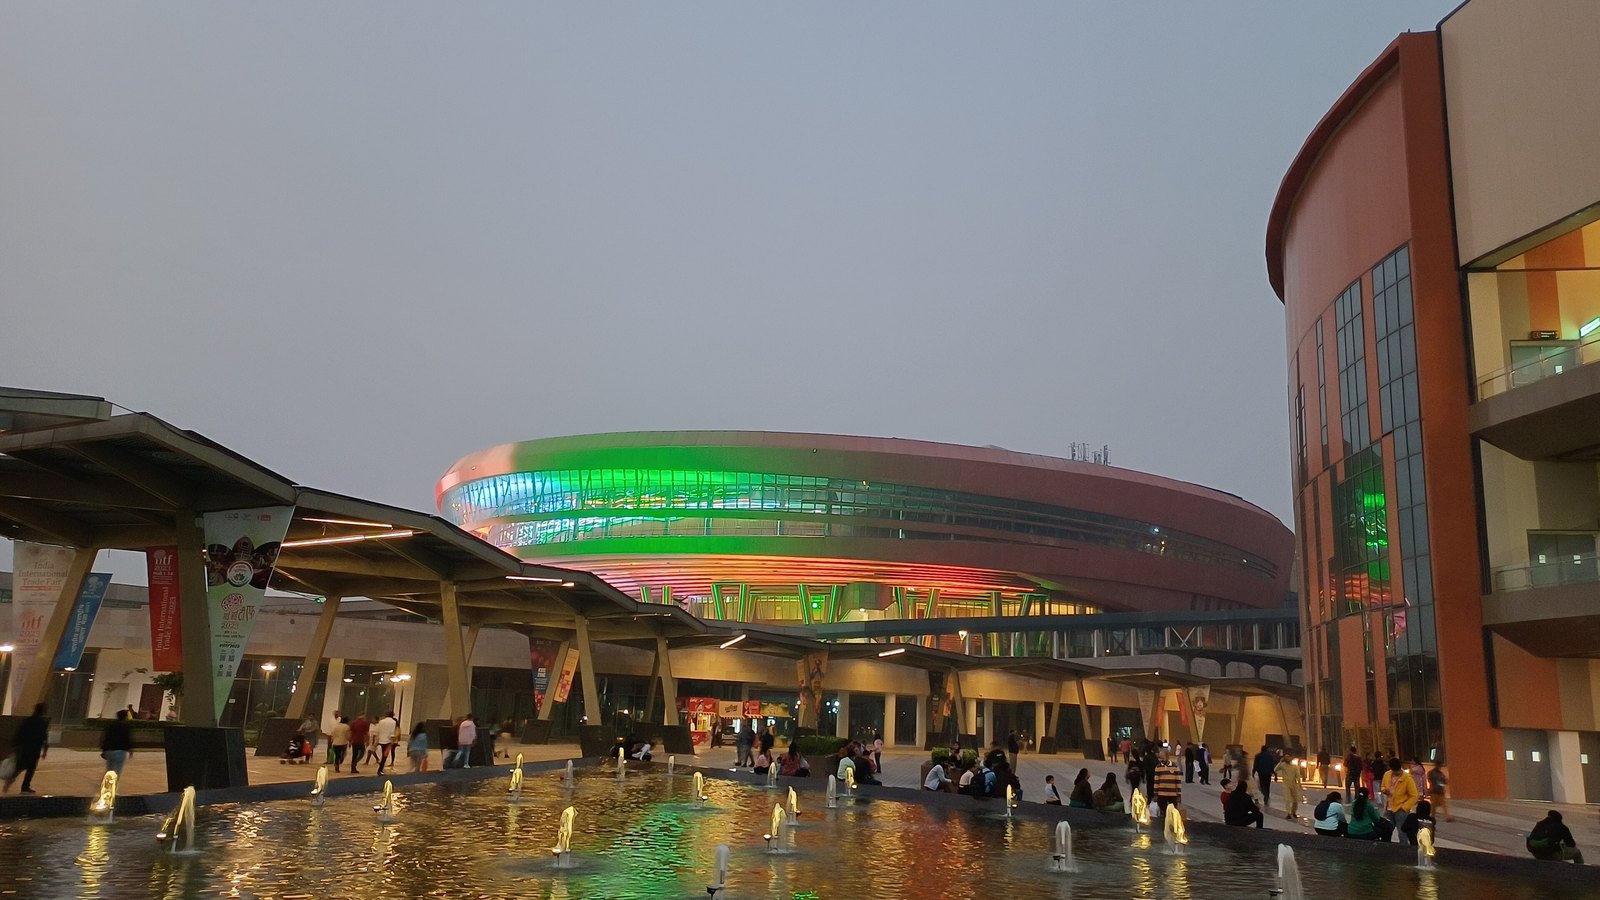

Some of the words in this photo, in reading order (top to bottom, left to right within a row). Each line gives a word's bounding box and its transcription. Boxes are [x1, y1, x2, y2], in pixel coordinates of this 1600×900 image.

[34, 561, 54, 569] India
[18, 569, 69, 578] International
[22, 577, 45, 586] Trade
[47, 577, 62, 586] Fair
[157, 586, 169, 631] International
